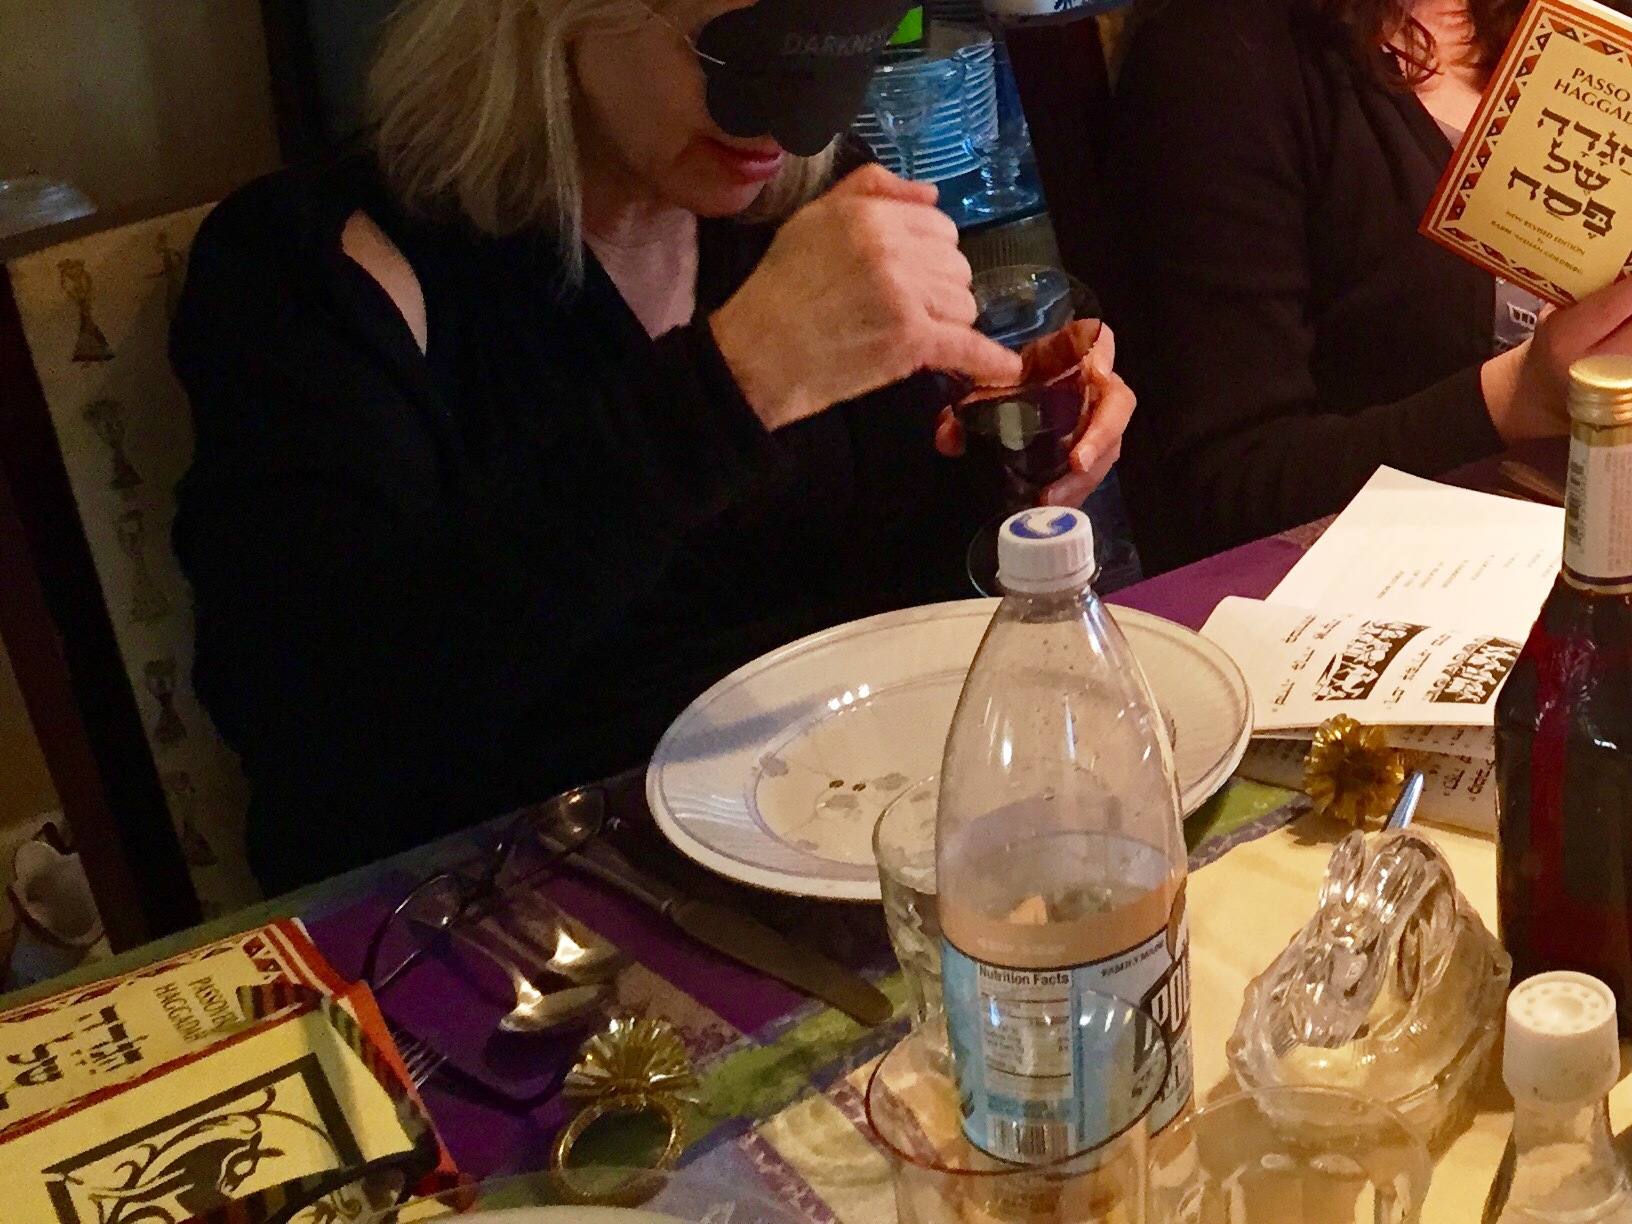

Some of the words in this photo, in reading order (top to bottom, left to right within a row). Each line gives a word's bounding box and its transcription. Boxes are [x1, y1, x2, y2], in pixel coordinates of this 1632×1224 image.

[1524, 220, 1554, 239] REVISED
[1553, 236, 1586, 255] EDITION
[979, 964, 1031, 986] Nutrition
[1033, 972, 1070, 986] Facts
